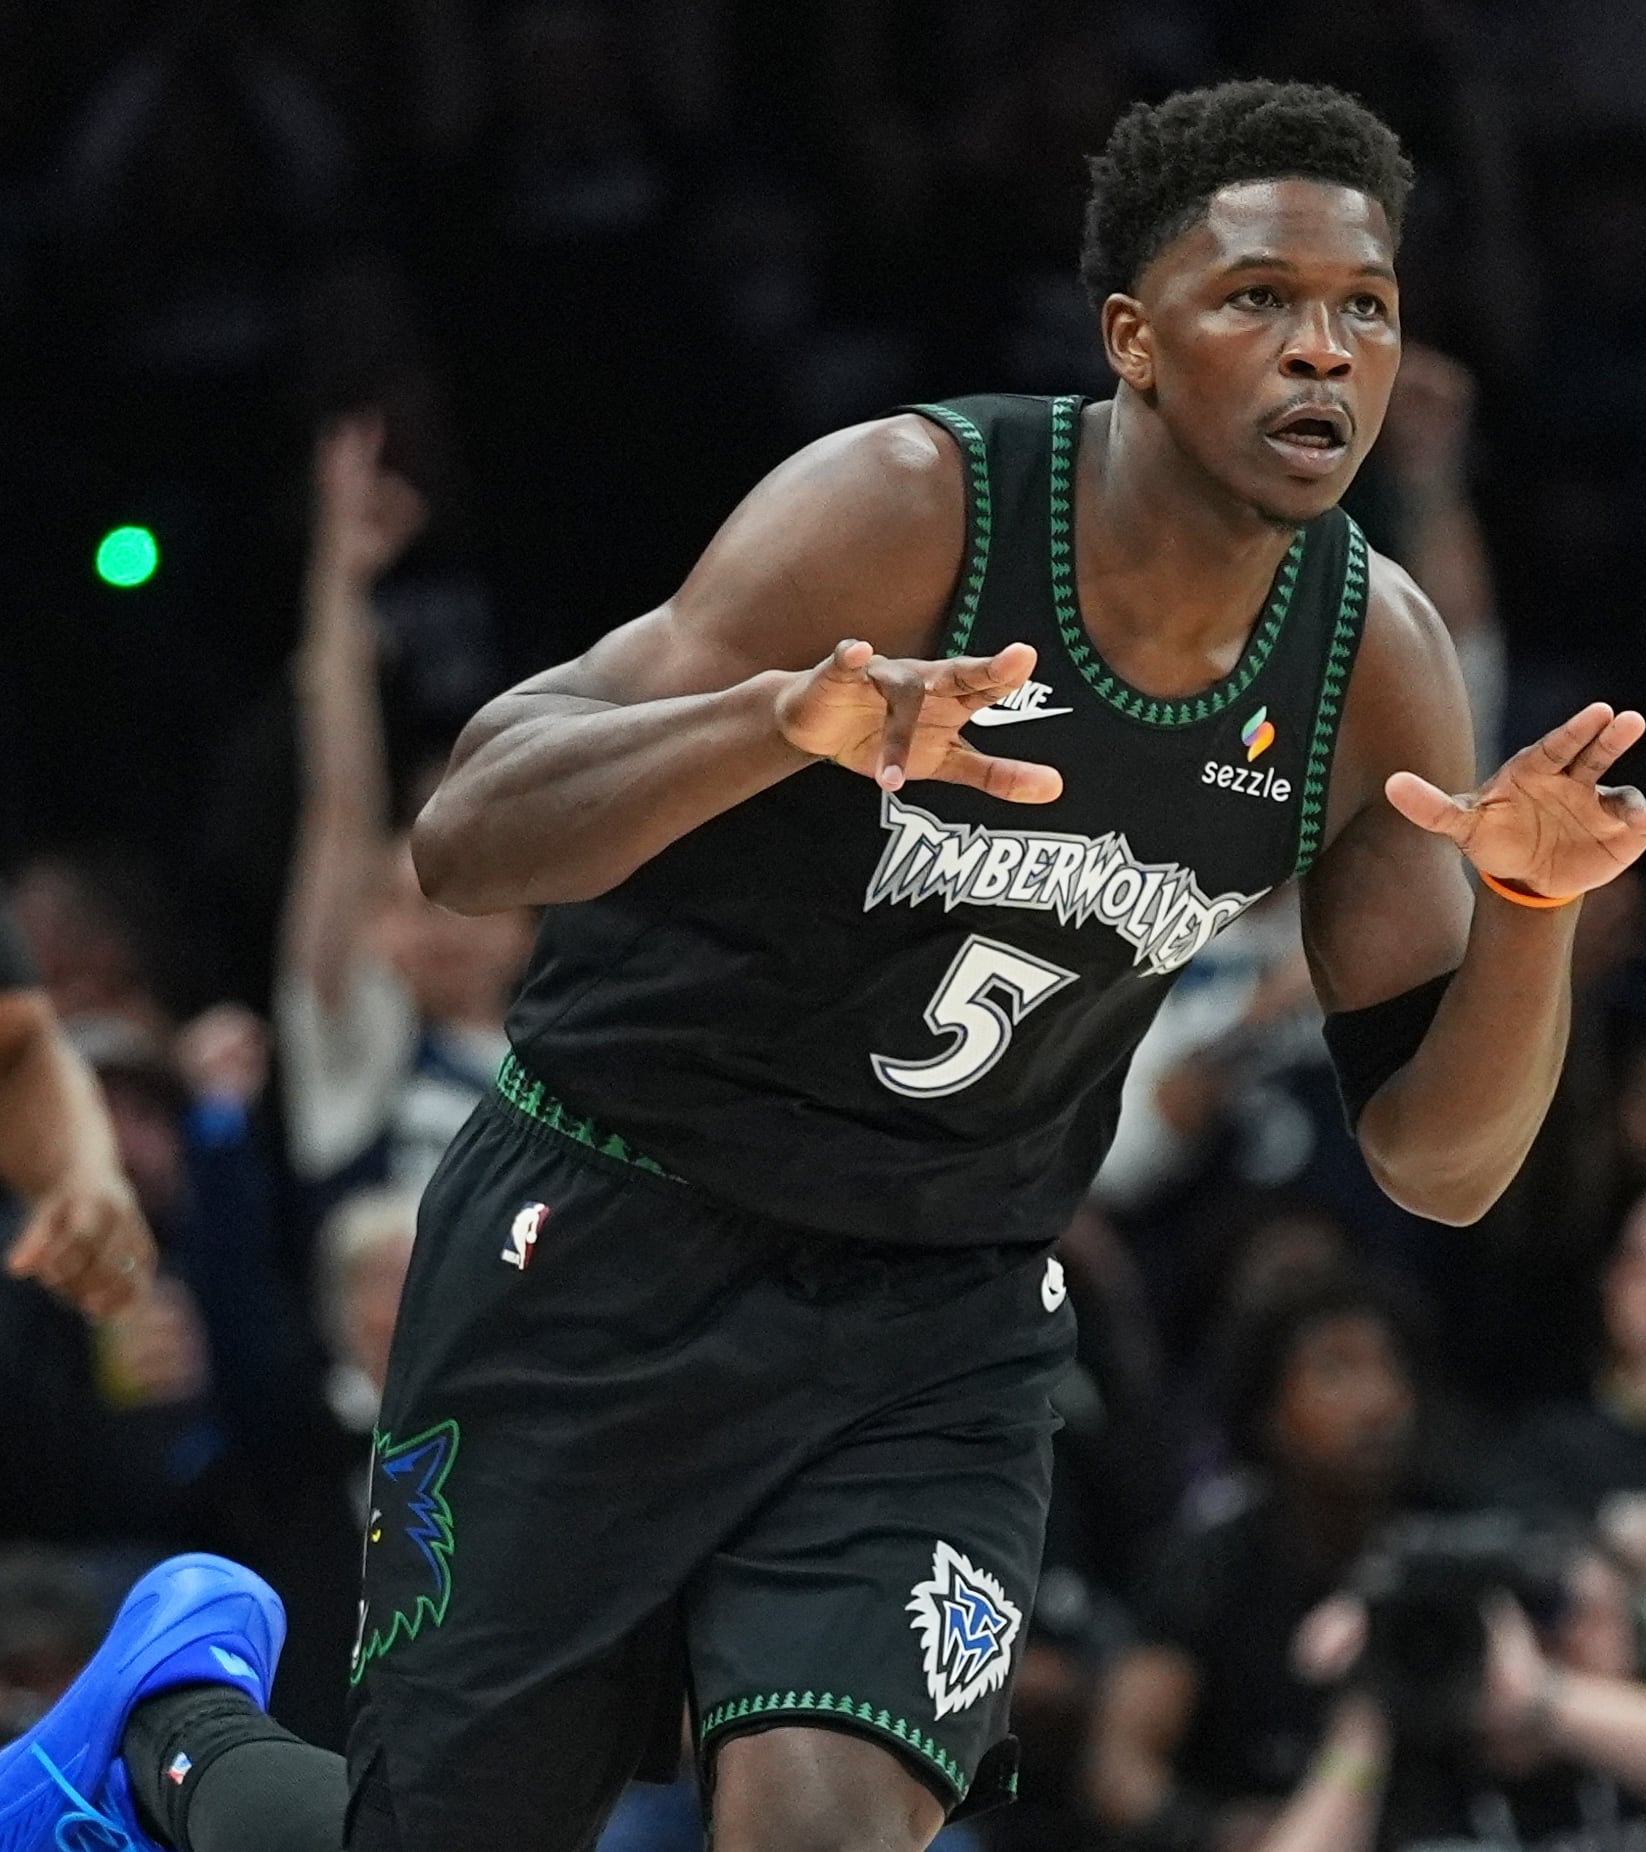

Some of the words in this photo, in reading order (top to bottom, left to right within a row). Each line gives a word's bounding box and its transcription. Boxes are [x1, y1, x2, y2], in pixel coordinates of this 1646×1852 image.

[996, 680, 1054, 711] IKE
[1201, 760, 1292, 802] sezzle
[863, 789, 1273, 978] TIMBERWOLVES
[870, 934, 1080, 1099] 5
